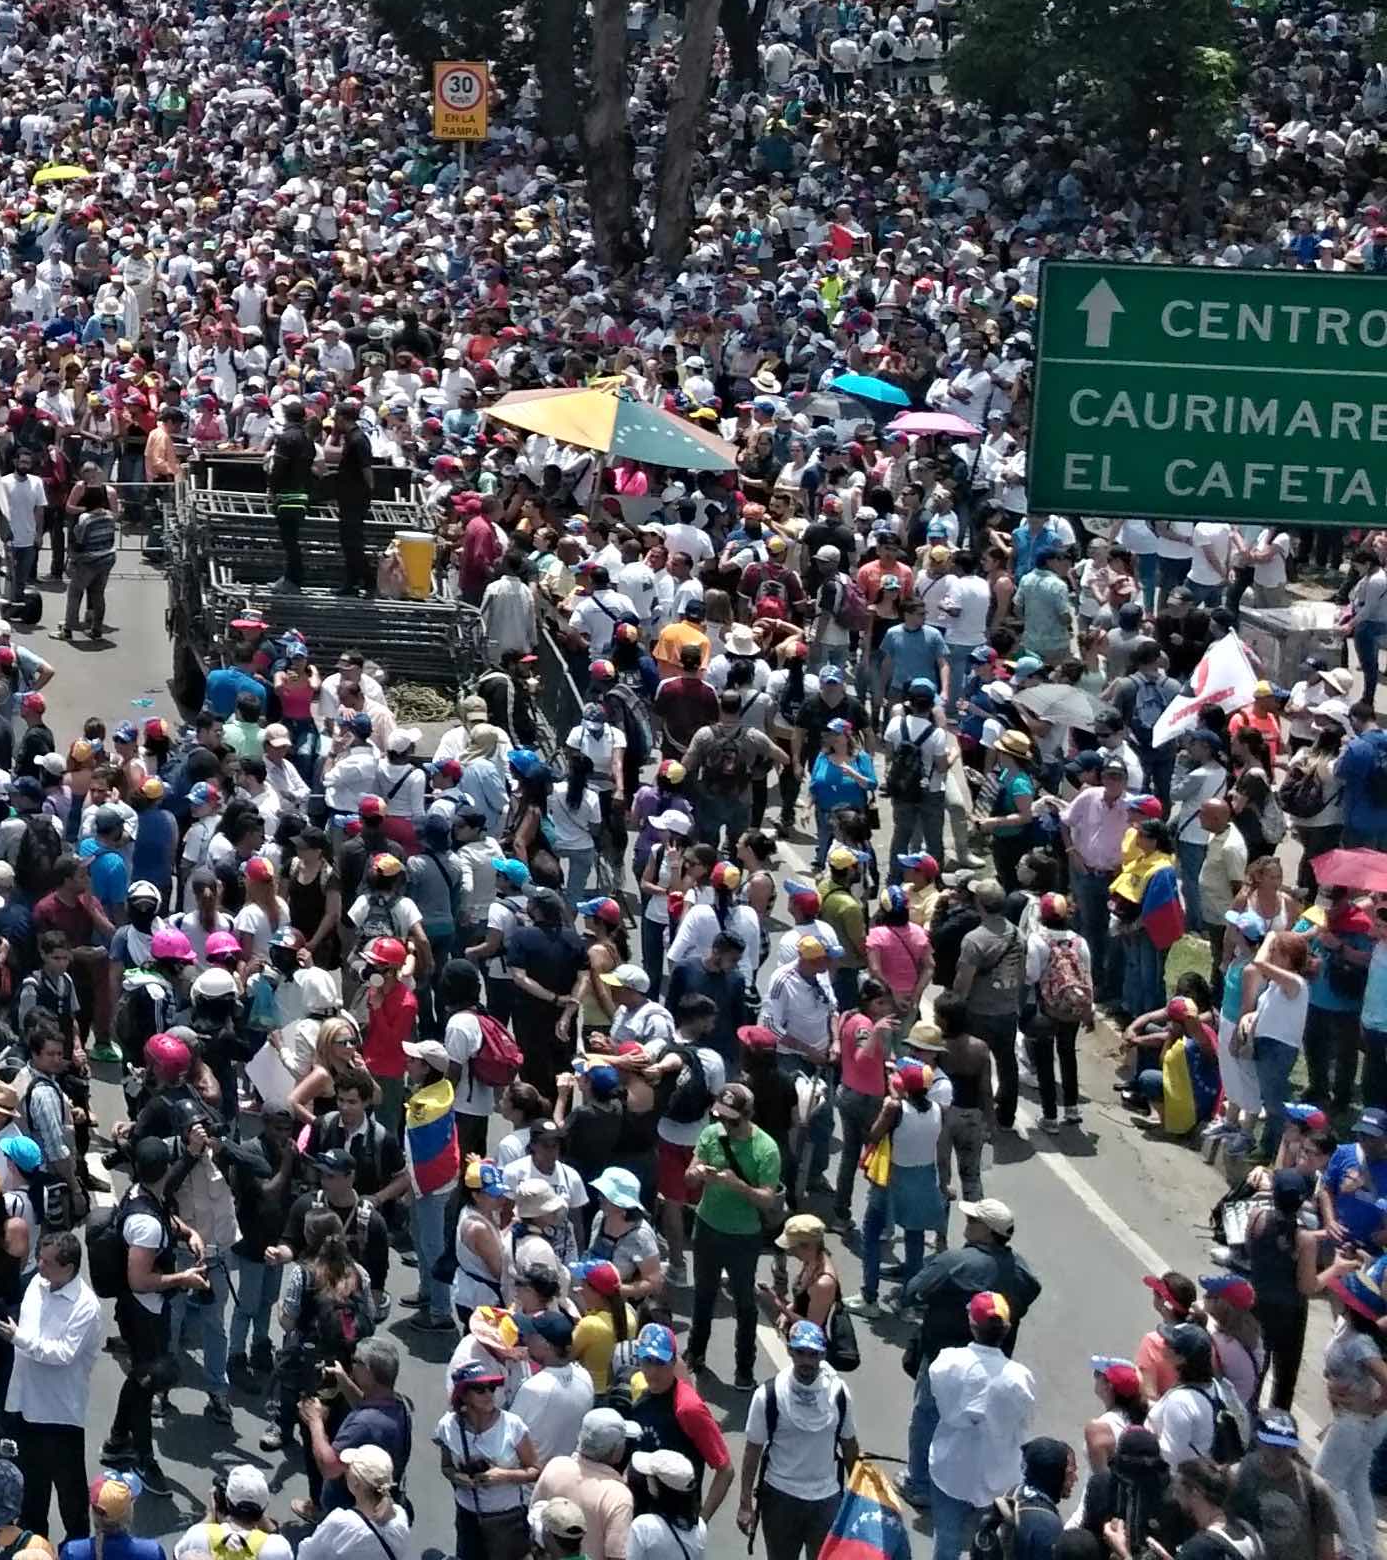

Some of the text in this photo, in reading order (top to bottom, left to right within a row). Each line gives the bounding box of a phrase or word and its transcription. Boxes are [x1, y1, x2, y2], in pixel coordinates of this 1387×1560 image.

[449, 76, 473, 93] 30
[445, 113, 475, 123] EN LA
[441, 126, 480, 136] RAMPA
[1161, 299, 1387, 347] CENTRO
[1063, 452, 1387, 507] EL CAFETA
